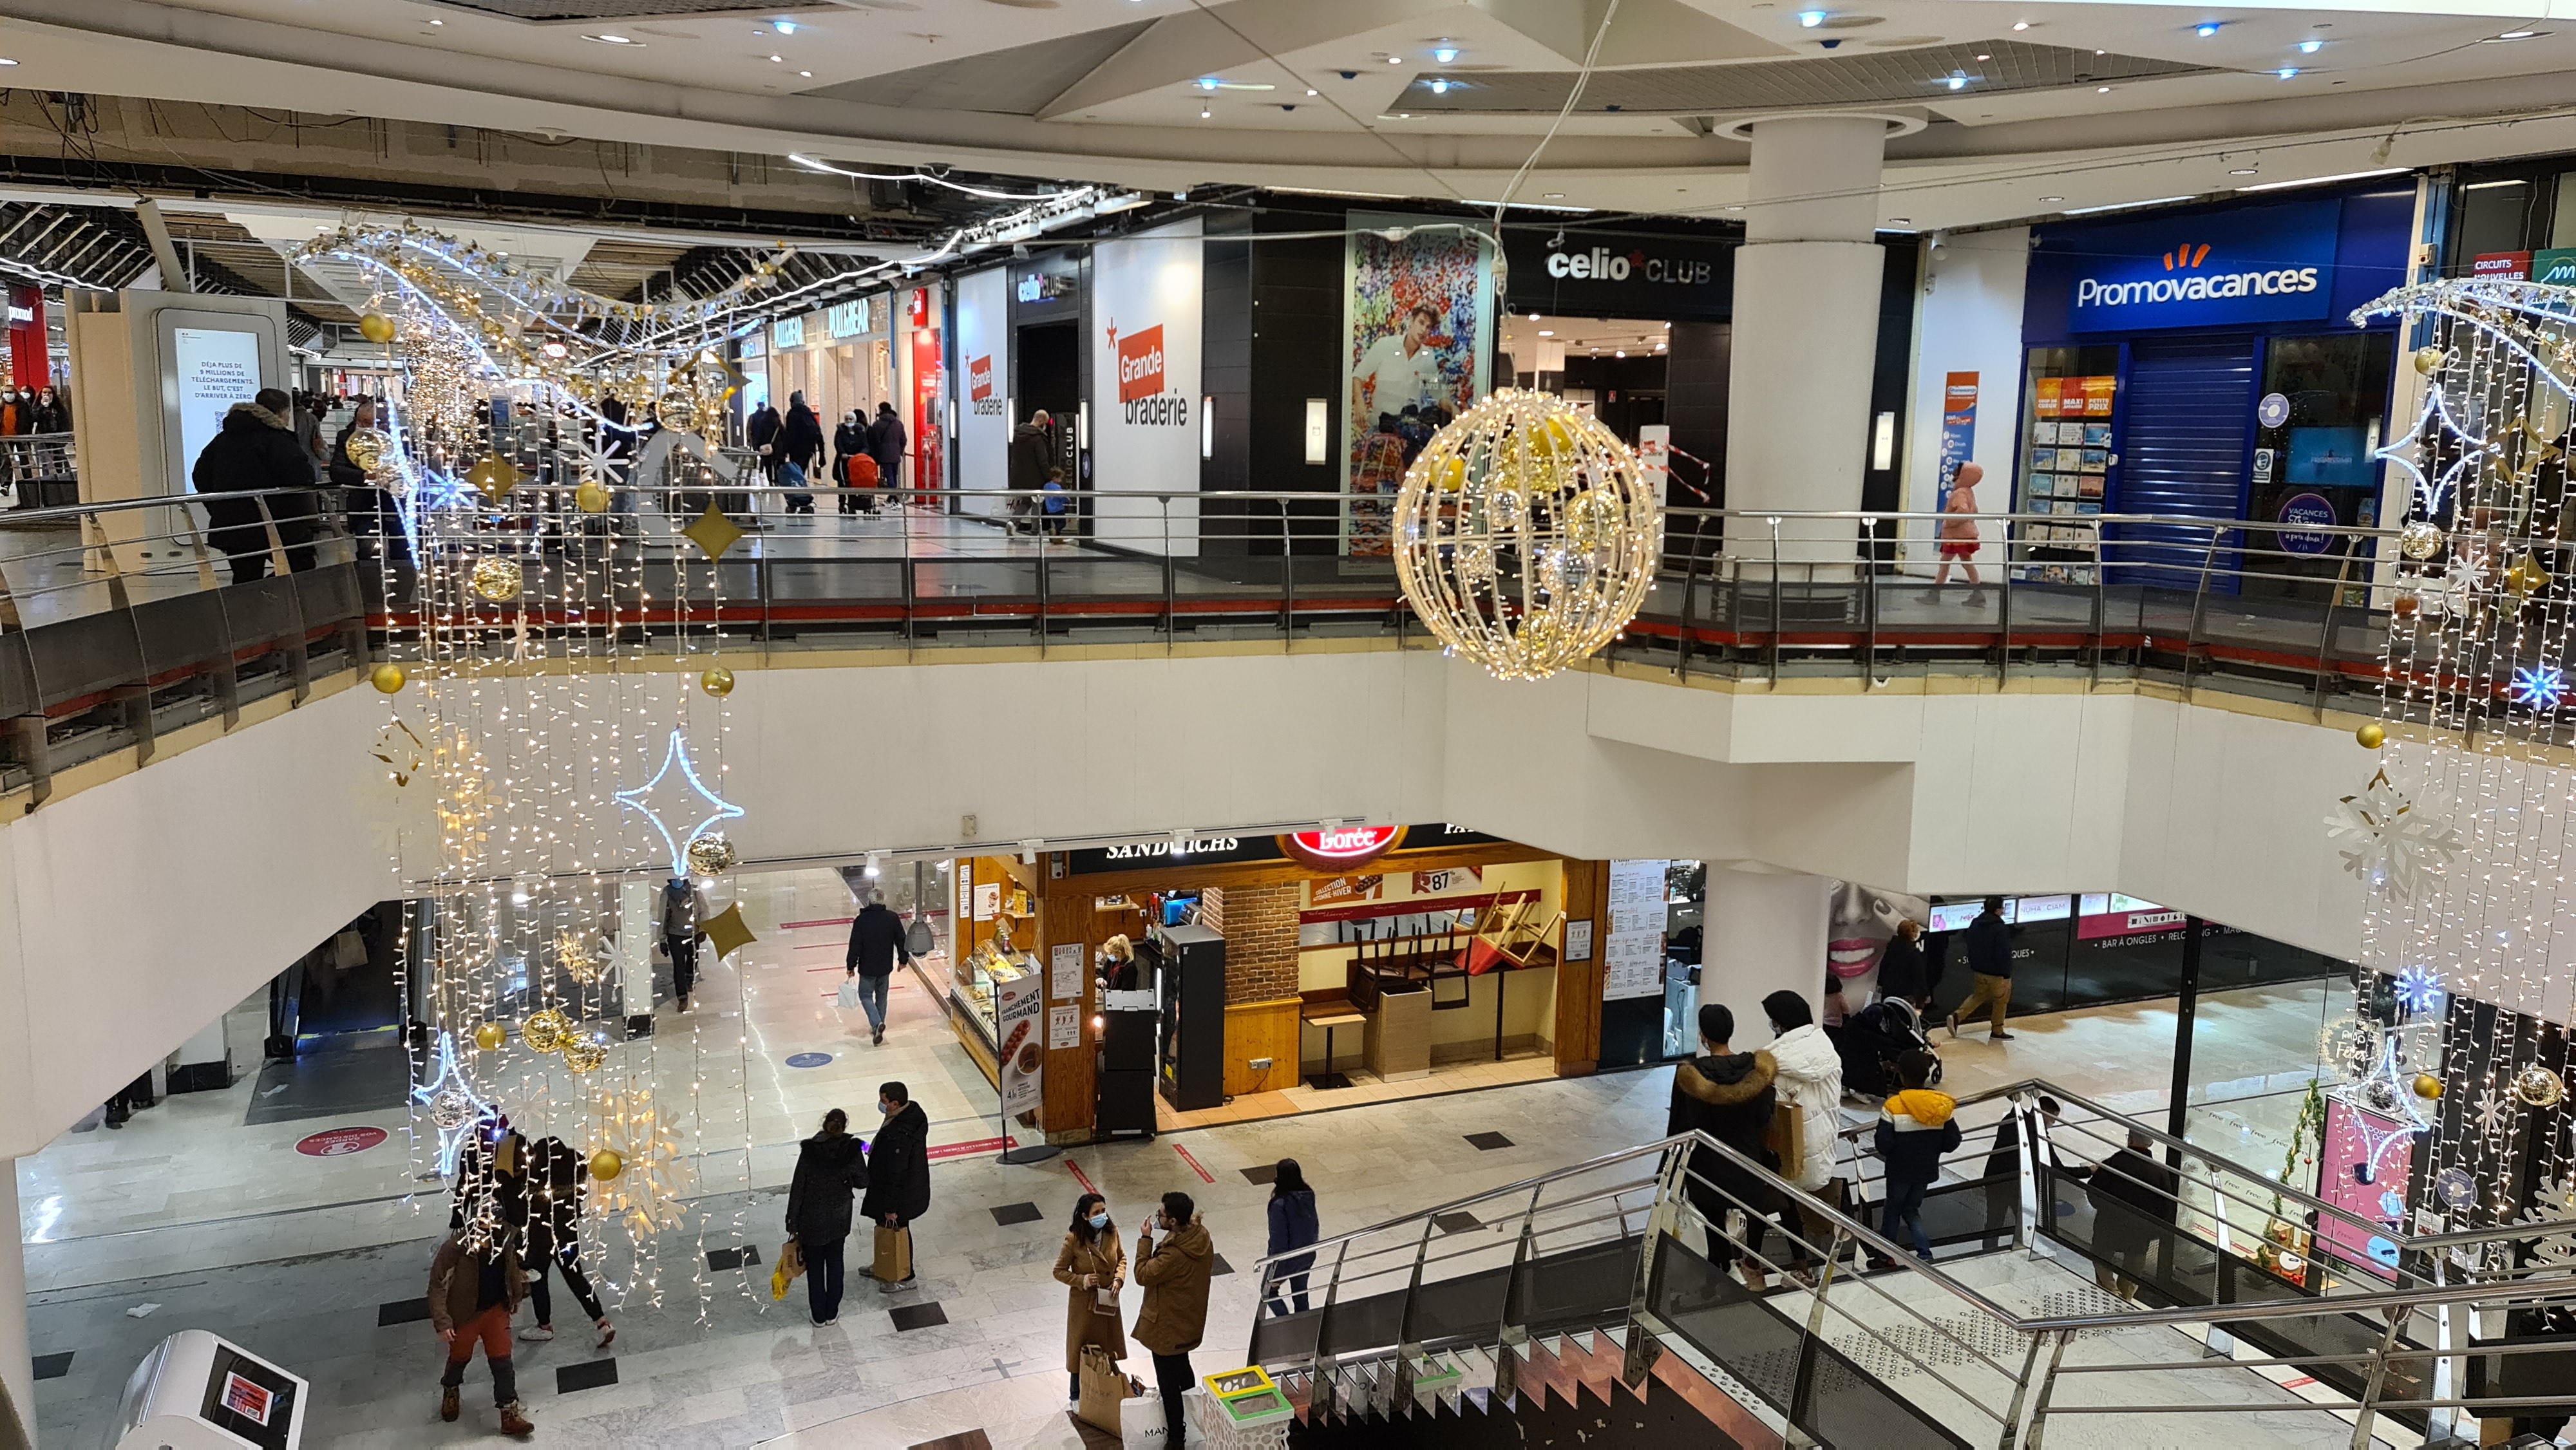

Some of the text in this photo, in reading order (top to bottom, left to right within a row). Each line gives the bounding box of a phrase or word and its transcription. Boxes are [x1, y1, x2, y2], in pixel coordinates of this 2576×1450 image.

[1548, 247, 1710, 283] celio CLUB
[2475, 259, 2512, 269] CIRCUITS
[2078, 267, 2318, 307] Promovacances
[829, 298, 869, 339] PULL&BEAR
[1121, 344, 1162, 384] Grande
[971, 367, 992, 390] Grande
[974, 392, 1003, 416] braderie
[1125, 388, 1188, 426] braderie
[2288, 507, 2329, 518] VACANCES
[1444, 823, 1474, 834] PA
[1106, 838, 1238, 859] SANDICHS
[1316, 876, 1347, 896] COLLECTION
[2102, 939, 2117, 948] BAR
[2119, 937, 2125, 947] À
[2126, 934, 2157, 946] ONGLES
[1001, 988, 1040, 1015] FRANCHEMENT
[1002, 1001, 1039, 1022] GOURMAND
[2208, 1112, 2224, 1121] free
[2250, 1129, 2267, 1139] free
[2272, 1138, 2289, 1148] free
[2224, 1180, 2240, 1190] free
[2246, 1189, 2262, 1200] free
